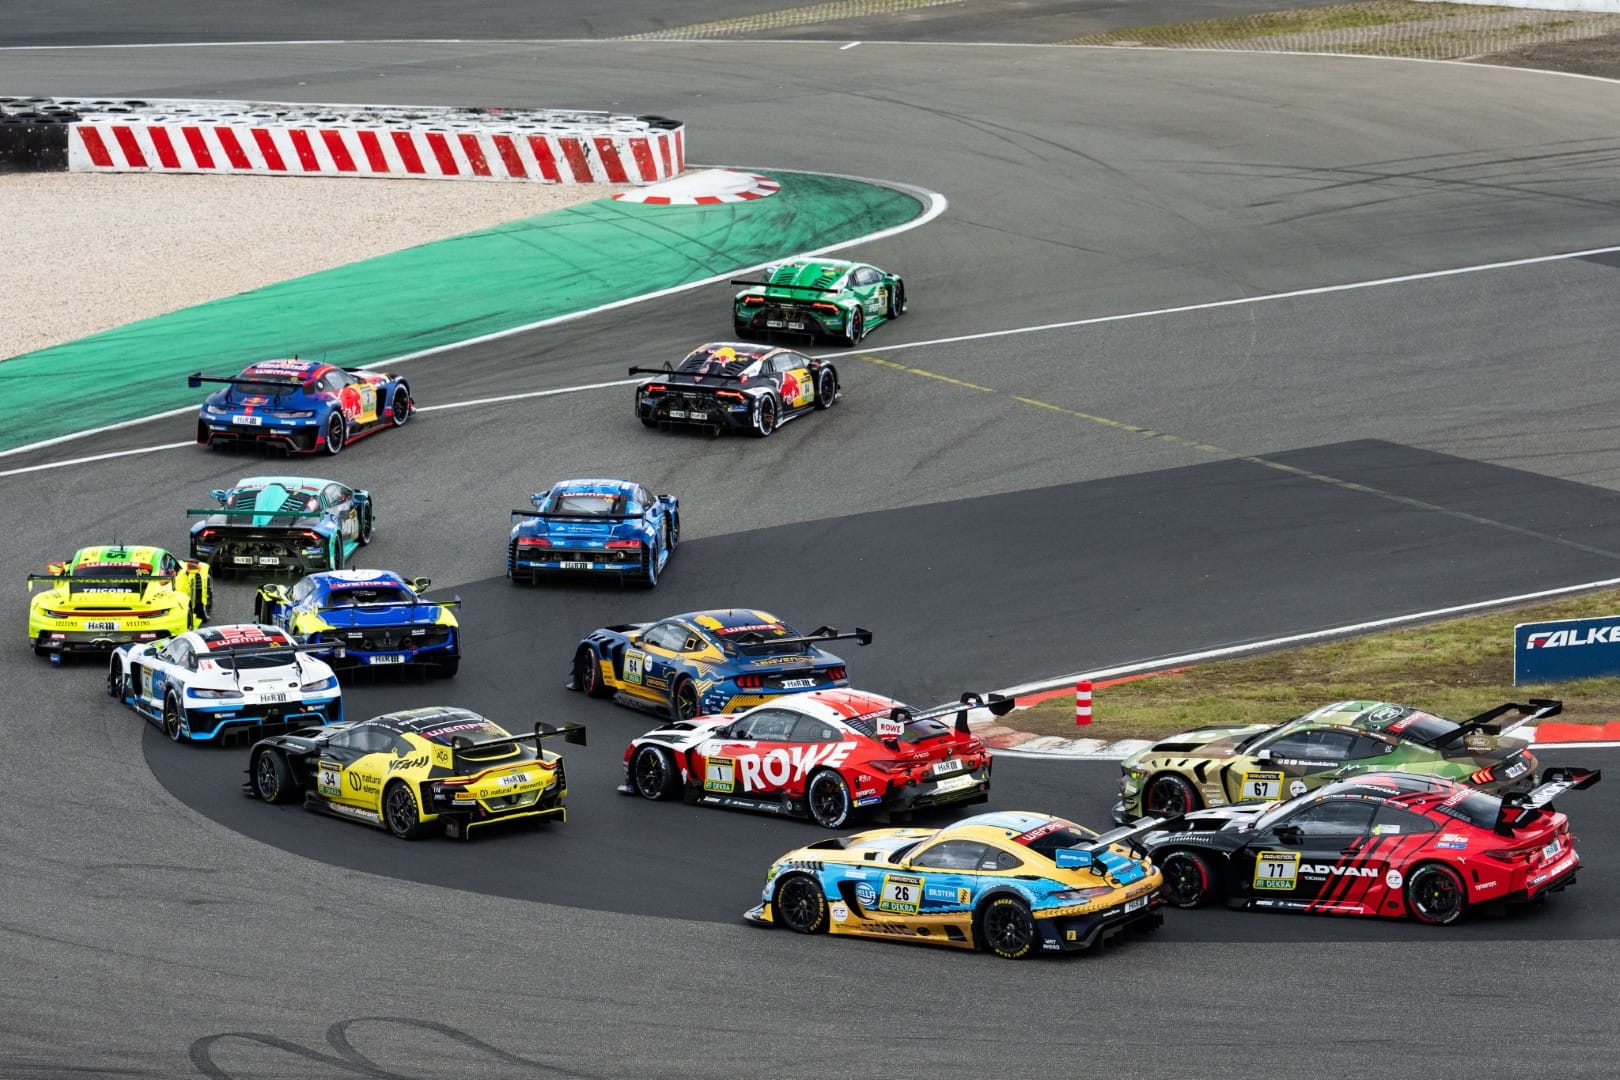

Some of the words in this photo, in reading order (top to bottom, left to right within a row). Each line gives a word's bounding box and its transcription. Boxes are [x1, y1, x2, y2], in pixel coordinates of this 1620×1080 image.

[217, 636, 272, 646] WEMPE
[880, 723, 901, 733] ROWE
[737, 741, 858, 792] ROWE
[325, 772, 335, 786] 34
[490, 787, 512, 796] natural
[1254, 782, 1268, 796] 67
[1269, 863, 1284, 878] 77
[1299, 864, 1379, 878] ADVAN
[1266, 880, 1291, 888] DEKRA
[895, 885, 909, 901] 26
[928, 887, 956, 898] BILSTEIN
[891, 902, 914, 912] DEKRA
